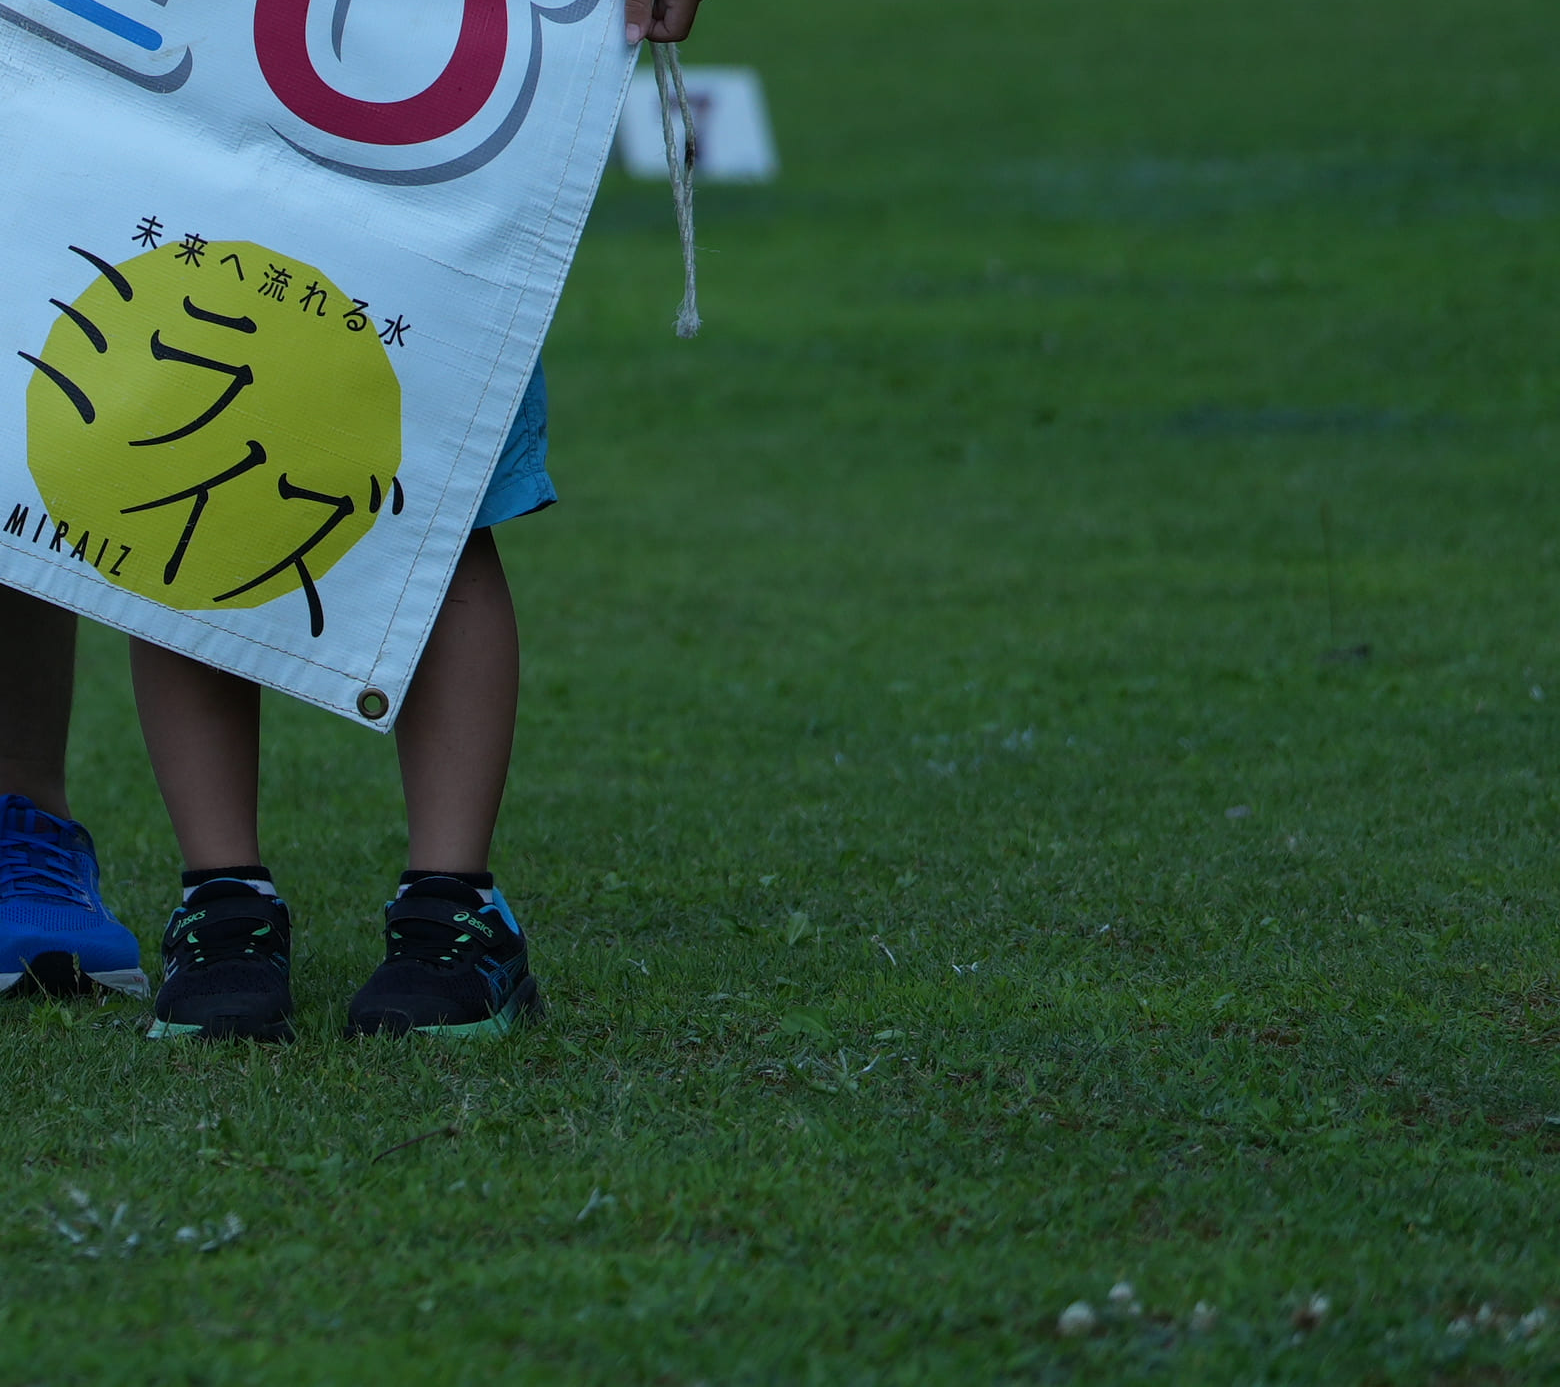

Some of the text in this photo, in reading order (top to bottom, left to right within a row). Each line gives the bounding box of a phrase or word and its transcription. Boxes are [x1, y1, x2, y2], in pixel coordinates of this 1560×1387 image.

[131, 215, 412, 348] 未来へ流れる水
[17, 245, 405, 638] ミライズ
[3, 503, 134, 577] MIRAIZ
[467, 917, 495, 939] asics
